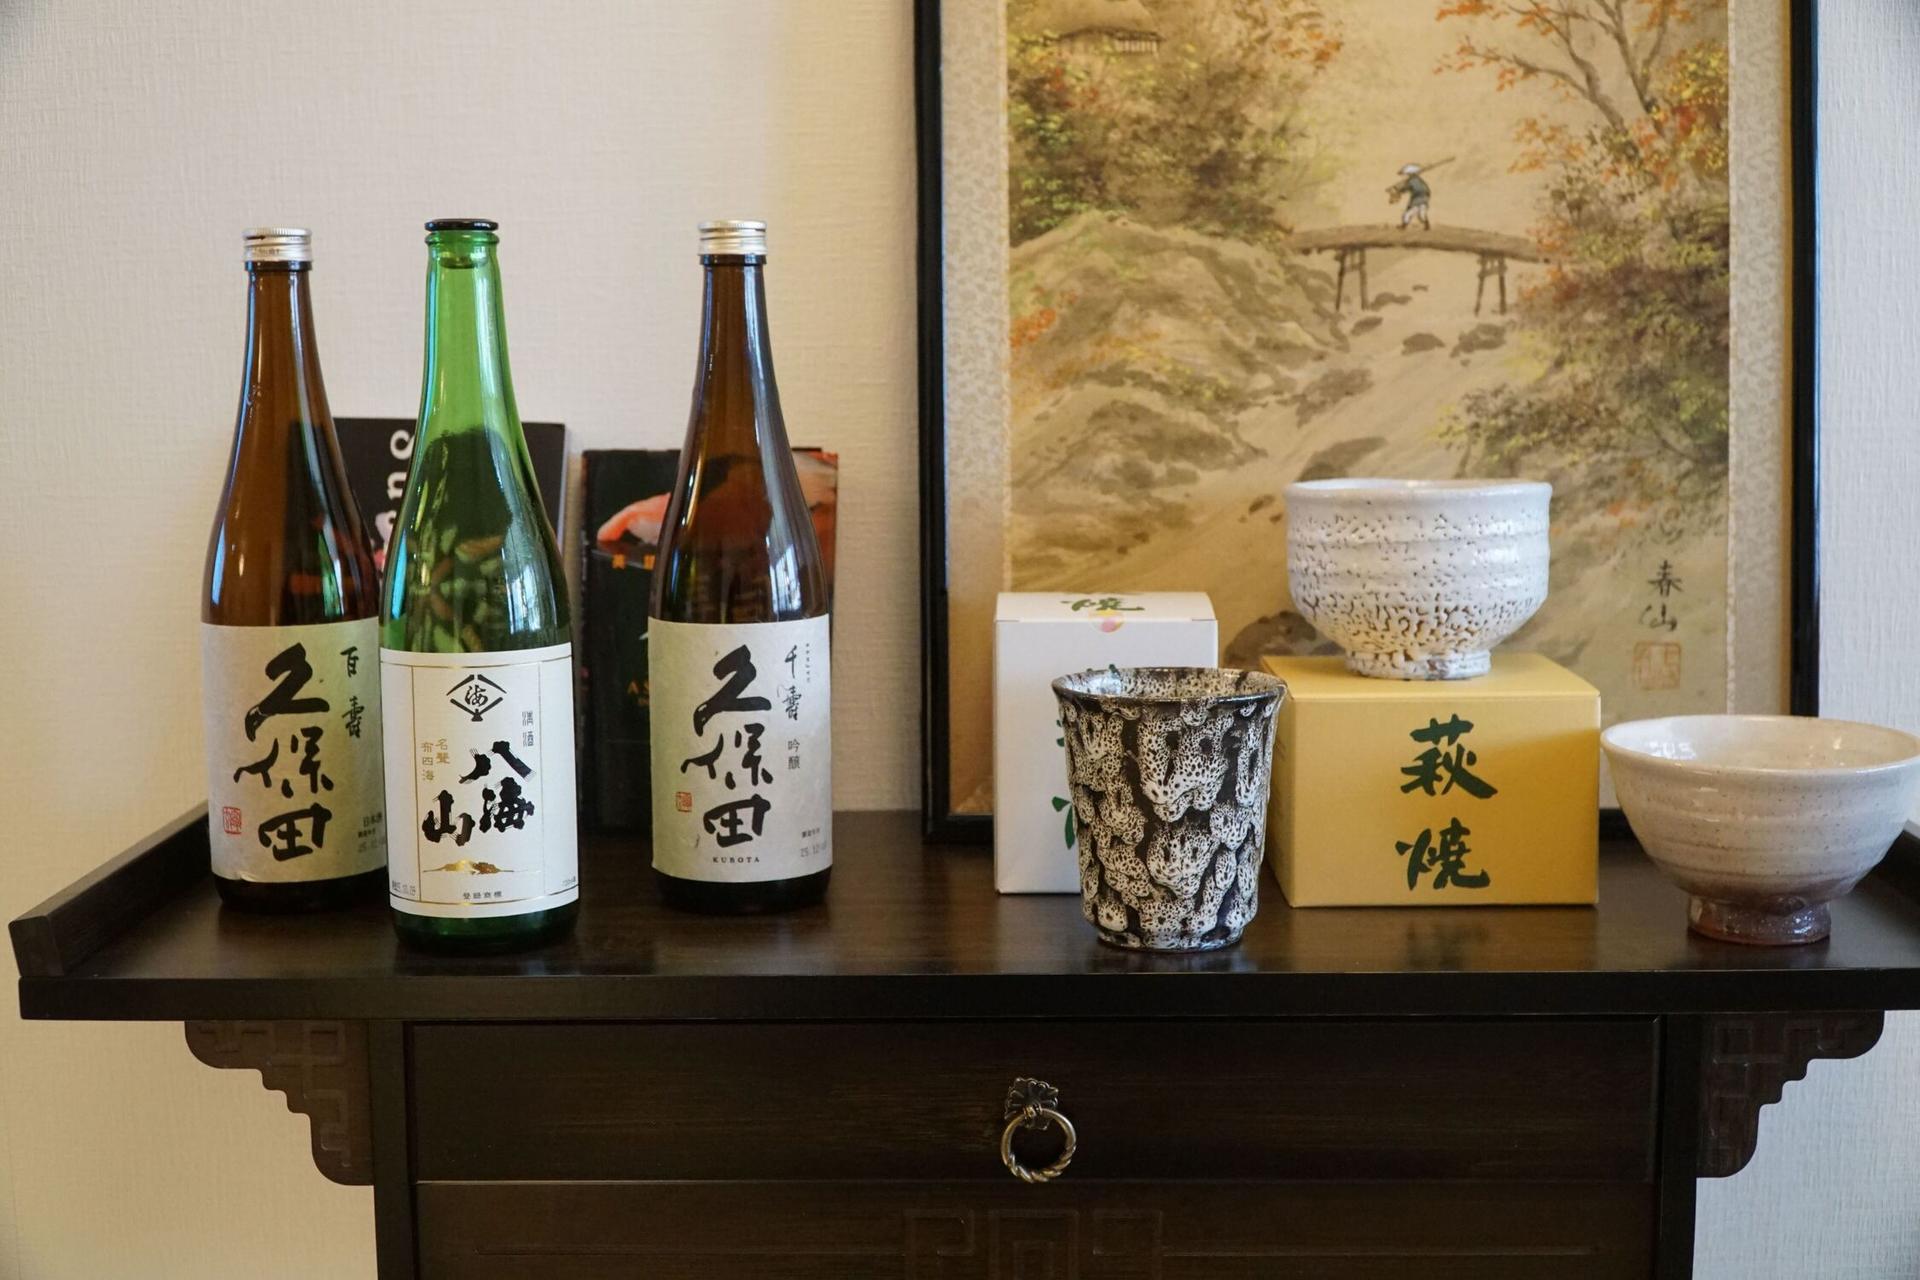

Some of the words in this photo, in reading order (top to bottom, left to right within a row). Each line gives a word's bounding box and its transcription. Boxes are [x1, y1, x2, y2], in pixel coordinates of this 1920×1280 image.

[233, 642, 334, 862] 久保田
[680, 644, 773, 848] 久保田
